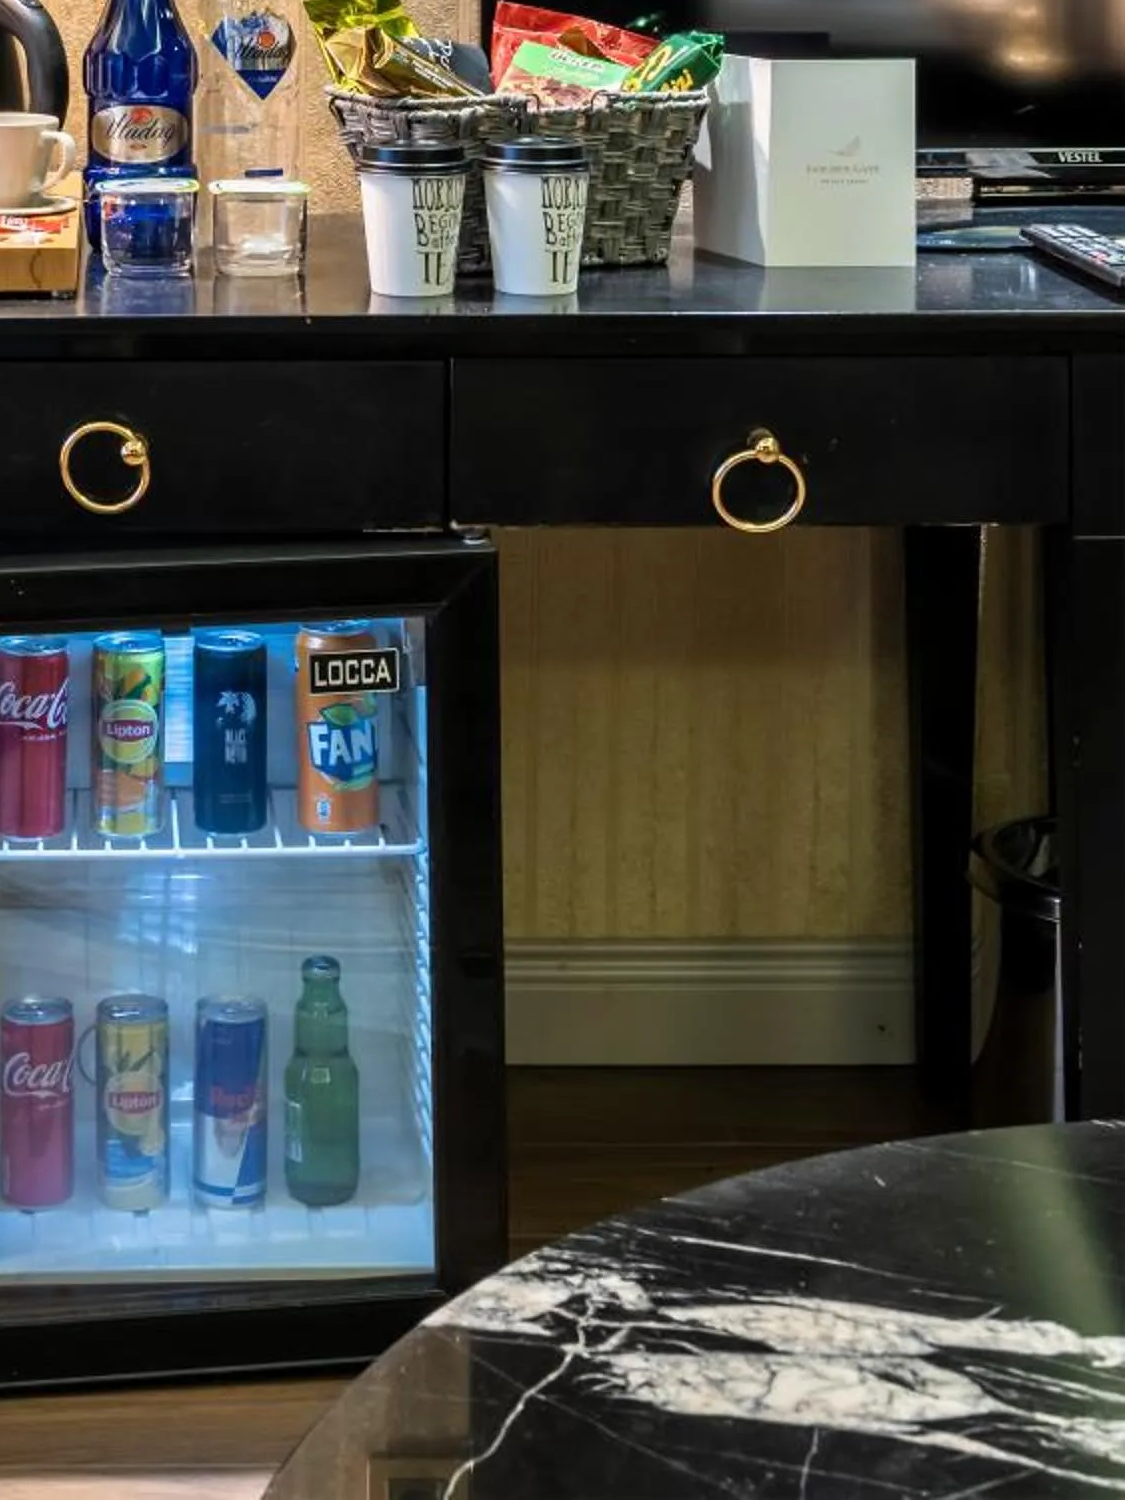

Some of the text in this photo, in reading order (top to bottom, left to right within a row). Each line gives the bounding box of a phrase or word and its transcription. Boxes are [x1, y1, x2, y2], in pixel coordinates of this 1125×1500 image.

[1057, 150, 1103, 163] VESTEL
[314, 656, 392, 687] LOCCA
[106, 722, 151, 737] Lipton
[111, 1094, 157, 1109] Lipton
